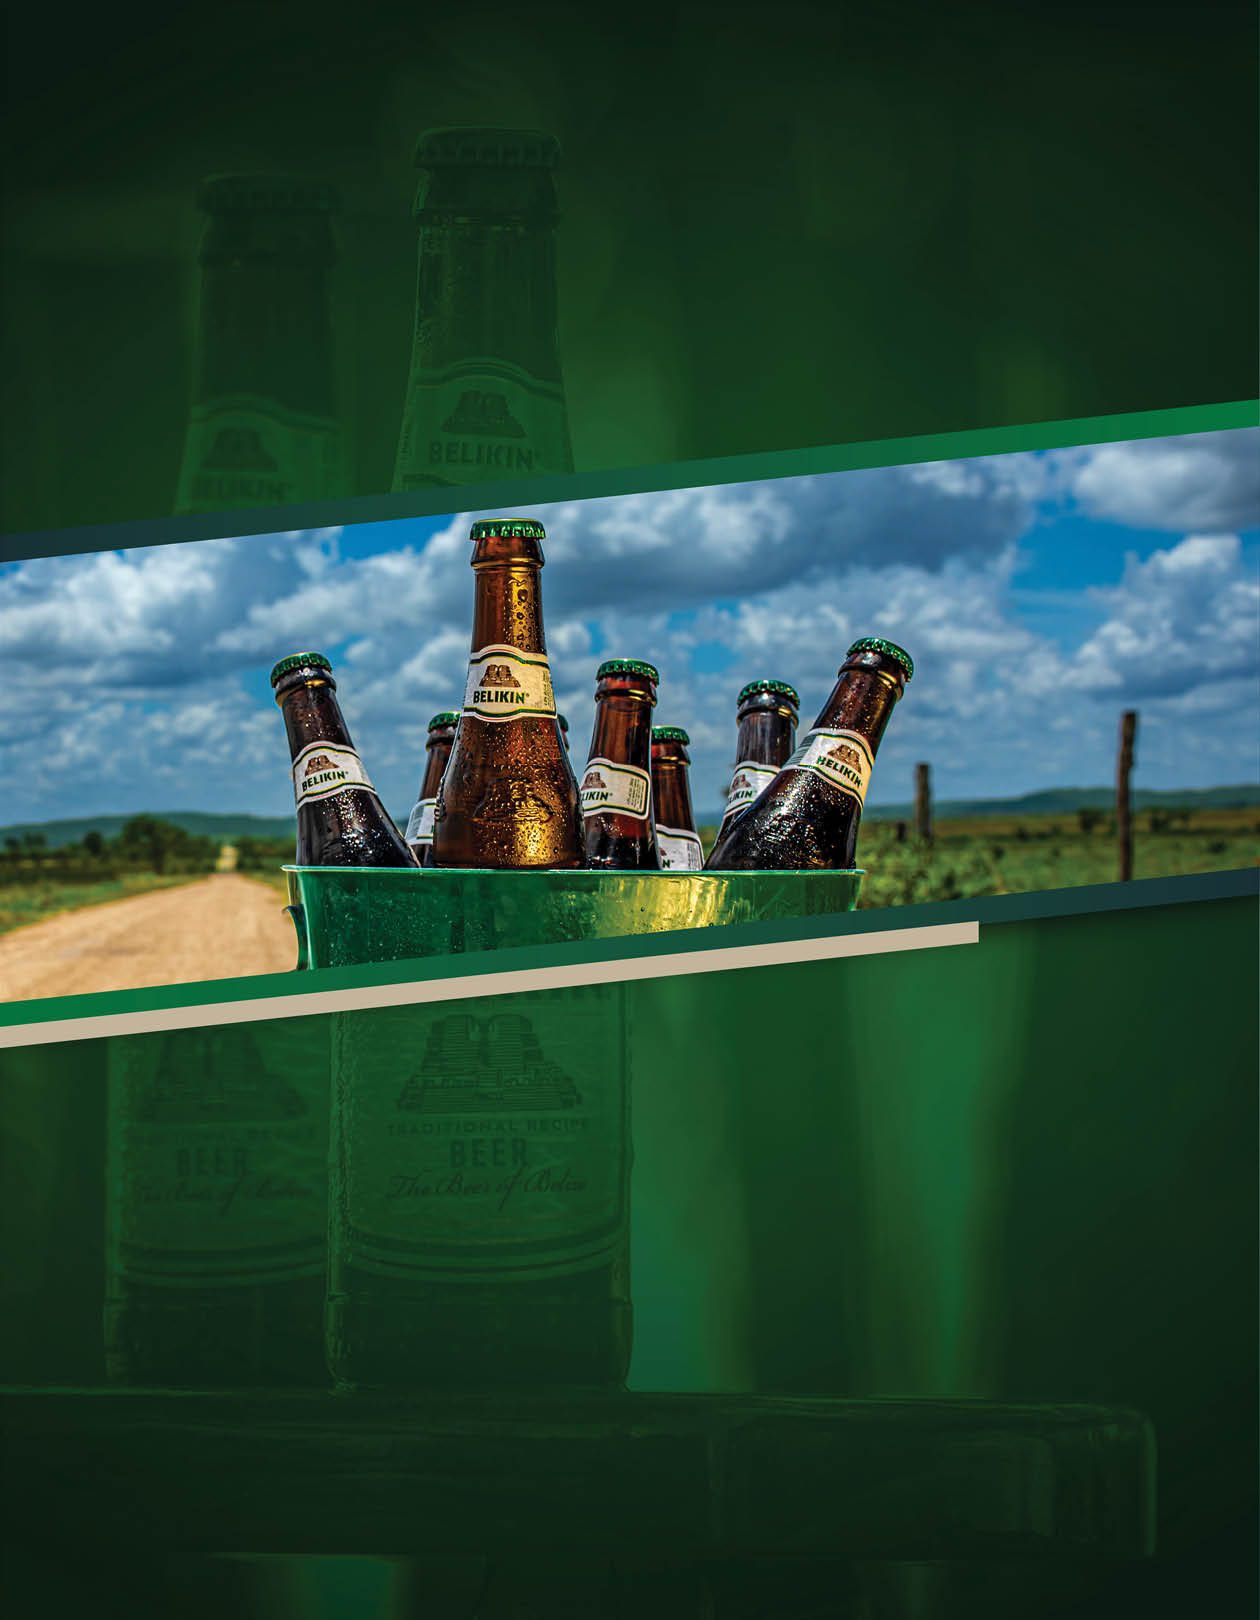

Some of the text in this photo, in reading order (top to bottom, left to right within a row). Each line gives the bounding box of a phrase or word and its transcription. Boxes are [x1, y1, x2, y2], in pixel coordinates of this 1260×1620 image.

[429, 440, 534, 471] BELIKIN
[473, 690, 526, 705] BELIKIN
[301, 770, 346, 792] BELIKIN
[816, 755, 862, 789] BELIKIN
[580, 791, 609, 801] LIKIN
[387, 1119, 516, 1136] TRADITIONAL
[177, 1147, 247, 1177] BEER
[450, 1138, 528, 1168] BEER
[386, 1171, 432, 1199] The
[436, 1170, 490, 1195] Beer
[495, 1168, 524, 1212] of
